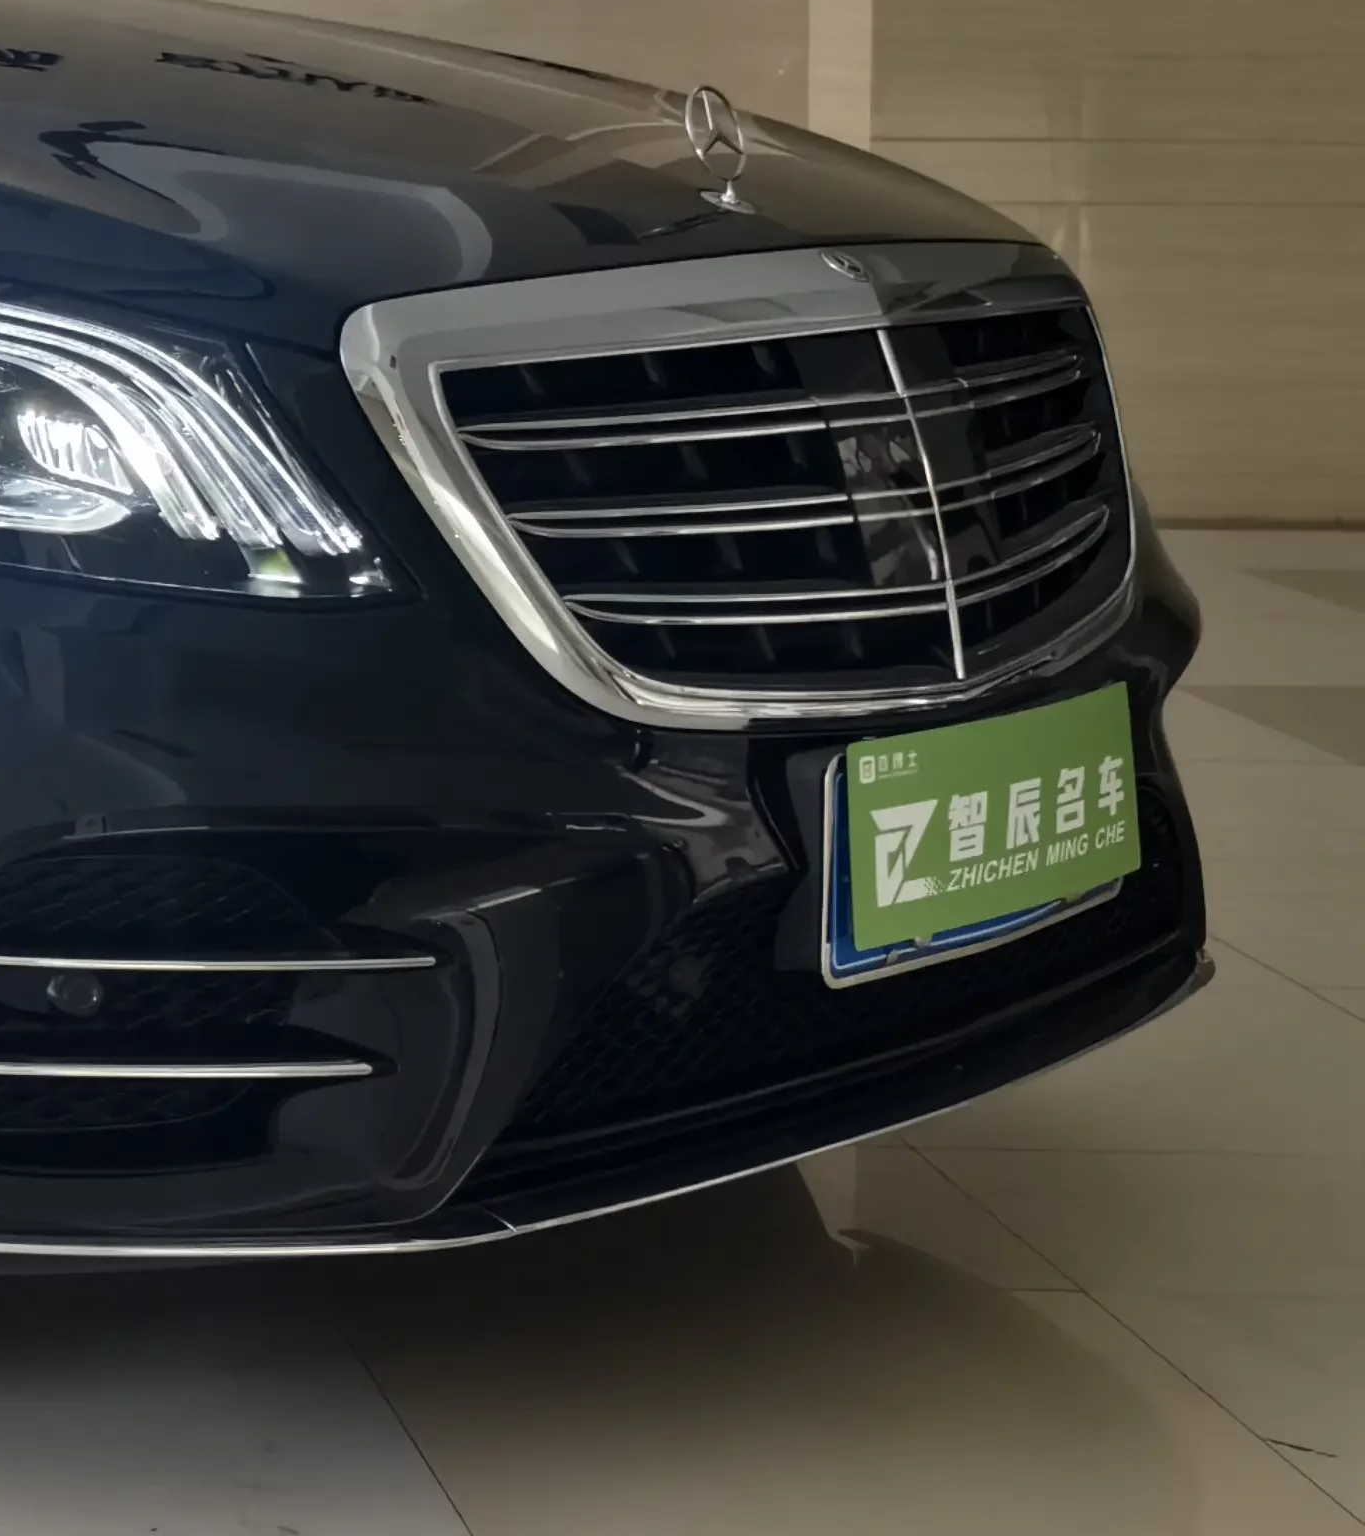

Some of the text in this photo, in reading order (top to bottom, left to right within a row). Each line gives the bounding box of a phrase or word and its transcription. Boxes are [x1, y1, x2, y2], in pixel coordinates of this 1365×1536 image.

[948, 754, 1126, 862] 智辰名车
[944, 819, 1126, 892] ZHICHEN MING CHE
